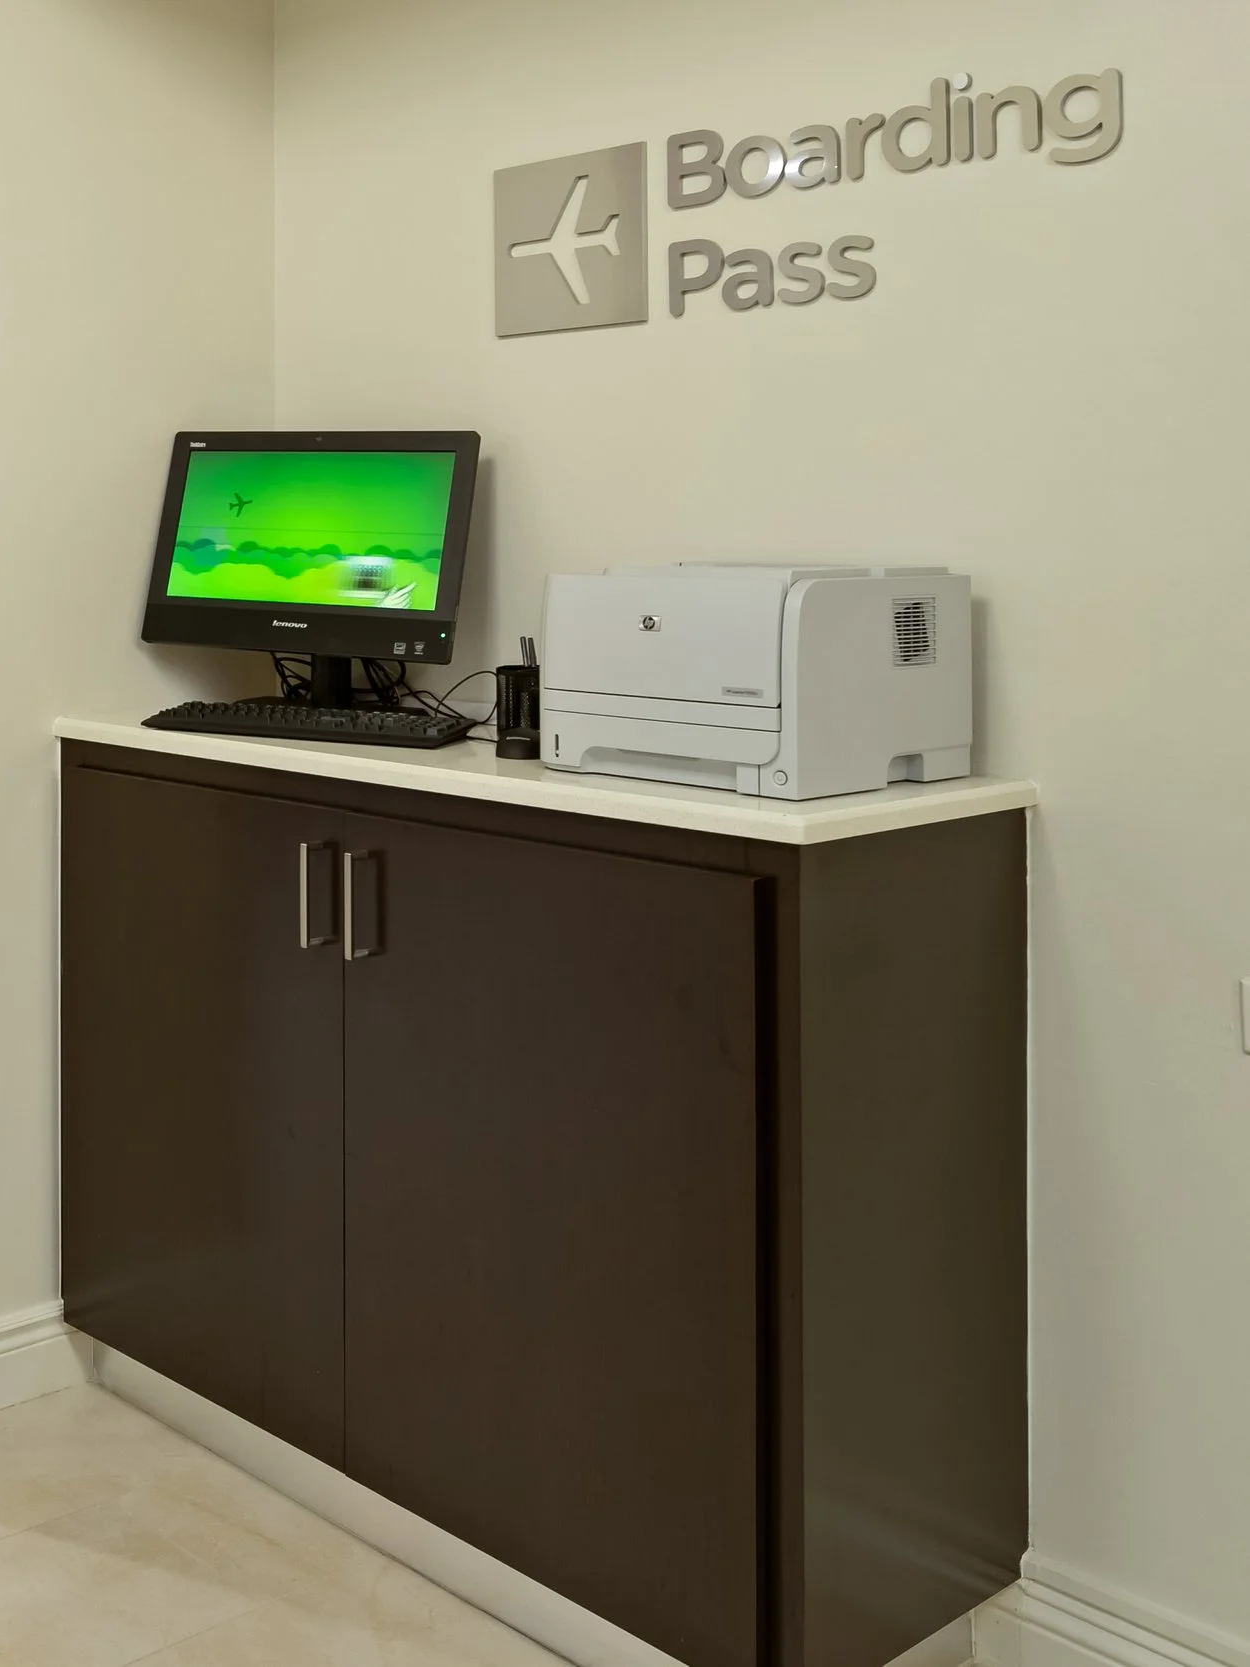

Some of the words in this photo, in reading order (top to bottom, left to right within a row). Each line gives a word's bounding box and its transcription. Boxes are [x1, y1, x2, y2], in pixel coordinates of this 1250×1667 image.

[666, 67, 1124, 211] Boarding
[667, 234, 878, 318] Pass
[272, 619, 308, 629] lenovo
